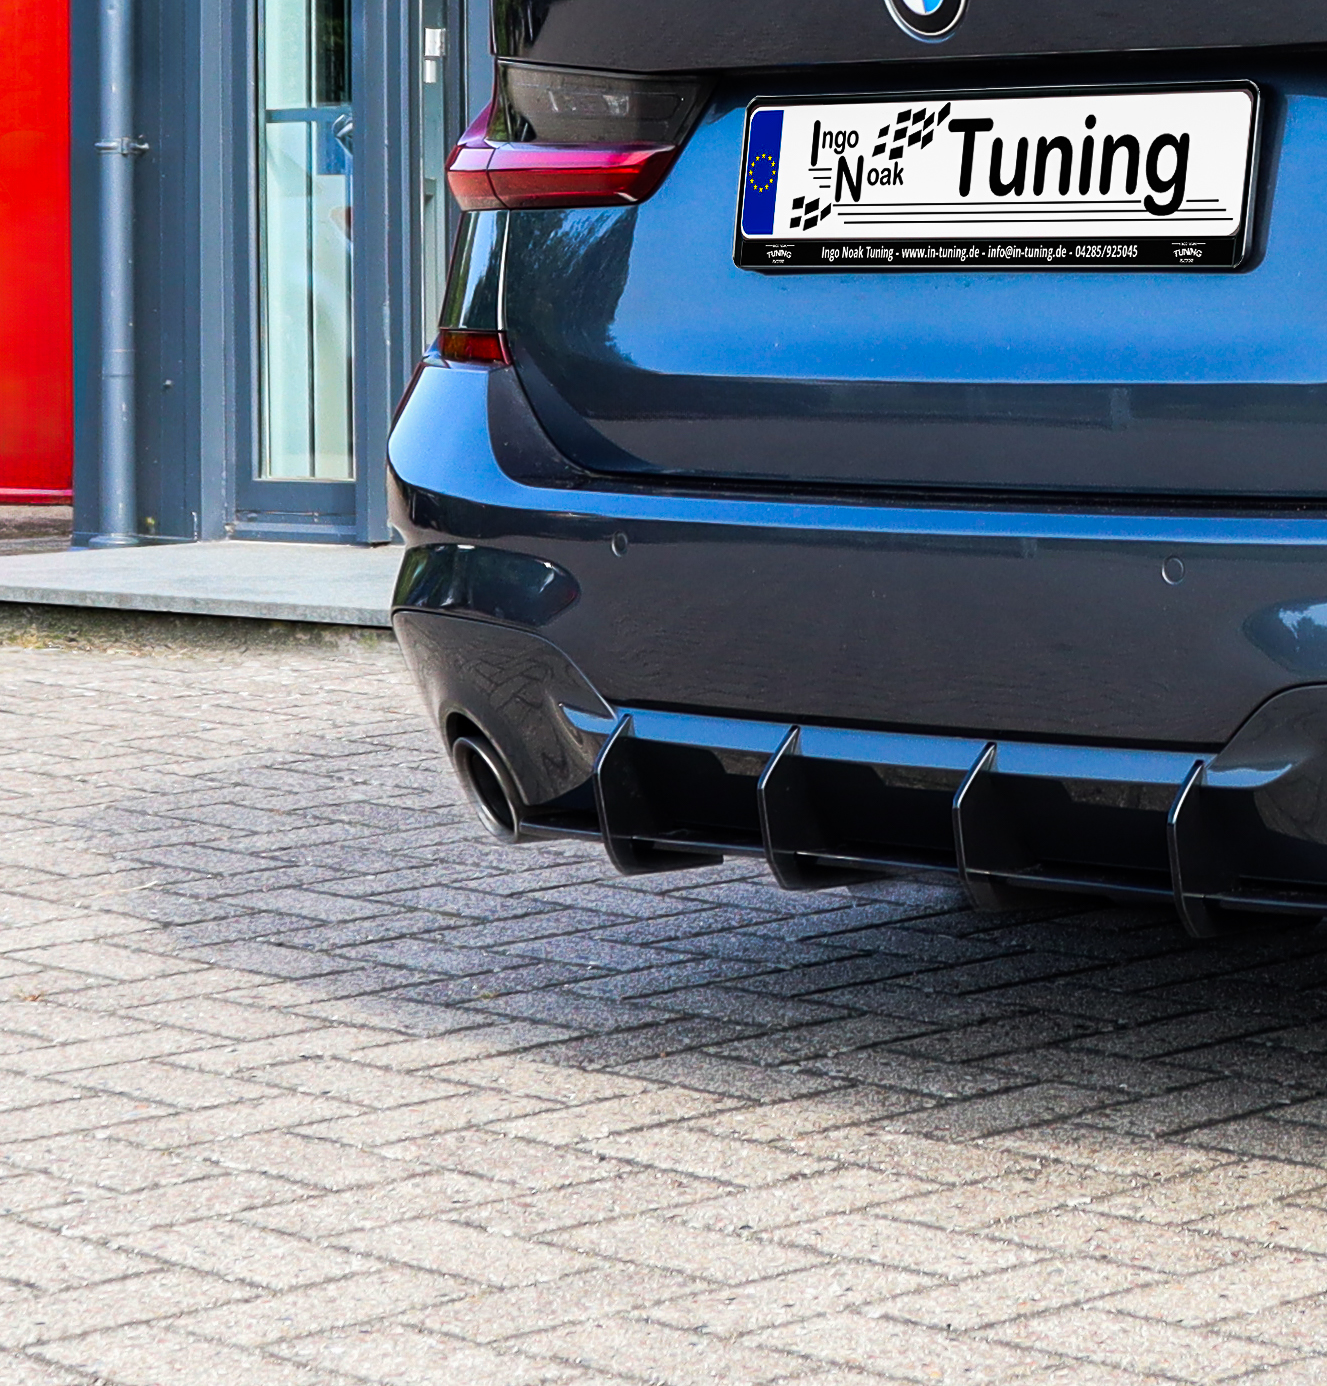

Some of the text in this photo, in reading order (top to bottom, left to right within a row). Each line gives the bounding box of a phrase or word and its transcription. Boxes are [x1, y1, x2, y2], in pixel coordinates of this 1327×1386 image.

[810, 119, 860, 167] Ingo
[947, 114, 1191, 216] Tuning
[834, 154, 904, 203] Noak
[821, 246, 840, 262] Ingo
[841, 245, 864, 259] Noak
[865, 245, 895, 262] Tuning
[901, 244, 980, 262] www.in-tuning.de
[987, 244, 1067, 262] info@in-tuning.de
[1075, 244, 1138, 259] 04285/925045
